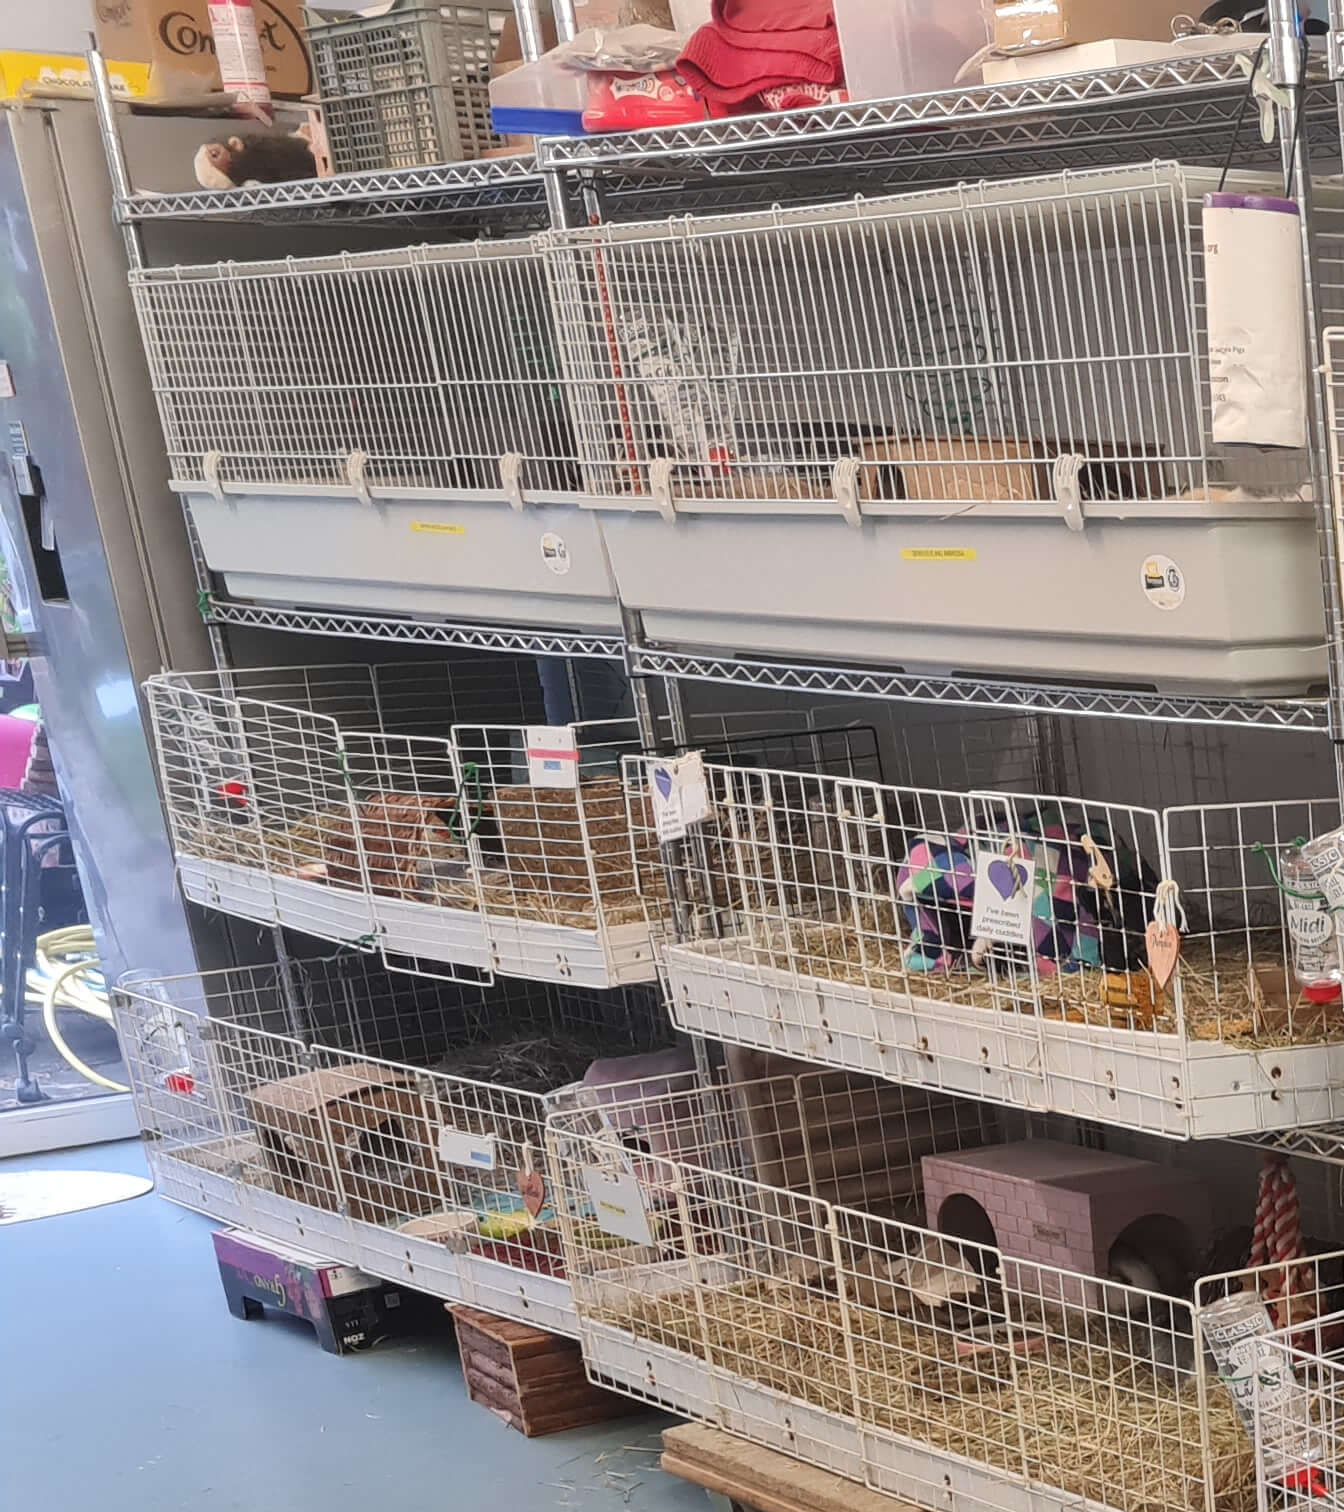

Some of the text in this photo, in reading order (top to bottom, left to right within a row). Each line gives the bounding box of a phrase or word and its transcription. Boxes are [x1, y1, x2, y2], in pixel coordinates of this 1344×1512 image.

[1309, 848, 1340, 869] SSIC
[985, 906, 1020, 920] I've been
[976, 924, 994, 935] daily
[1290, 914, 1326, 932] Midi
